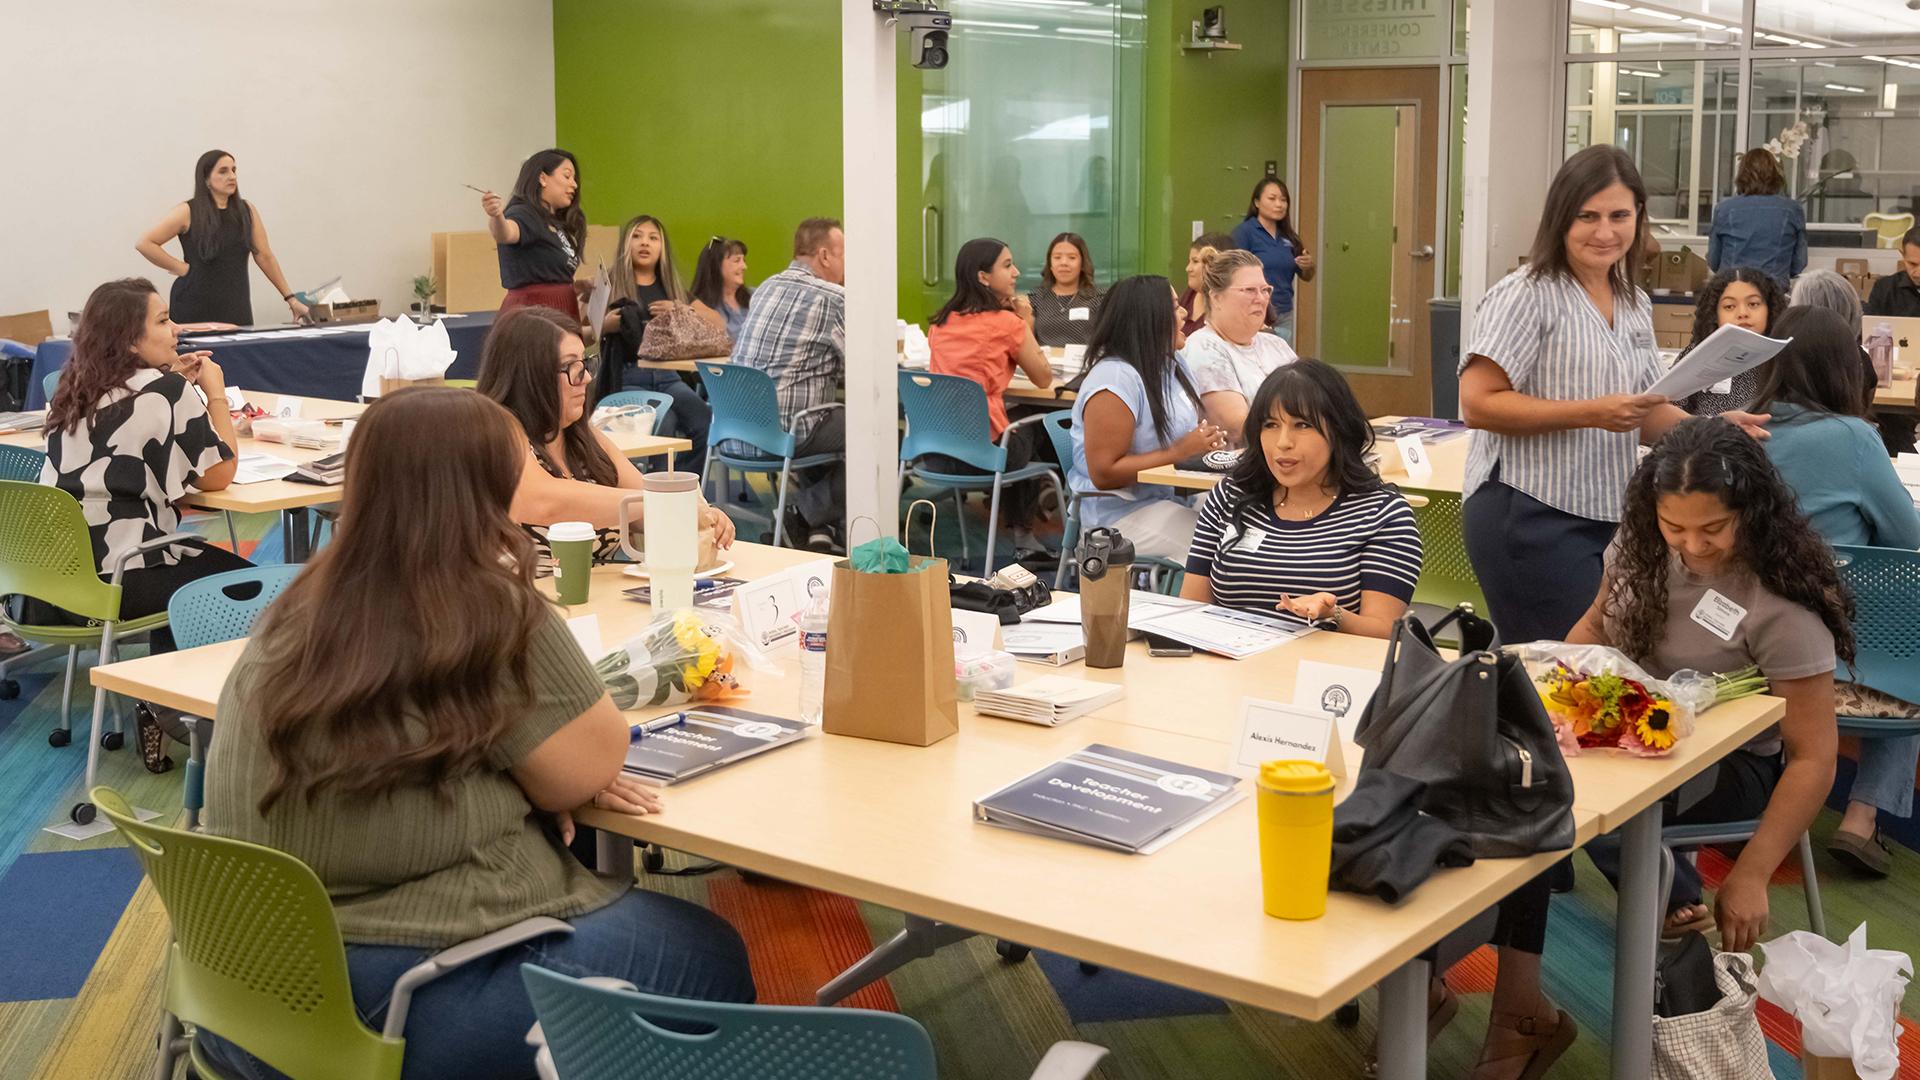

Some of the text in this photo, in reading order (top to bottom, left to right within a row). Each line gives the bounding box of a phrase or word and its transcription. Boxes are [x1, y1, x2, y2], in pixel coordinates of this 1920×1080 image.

[768, 594, 779, 625] 3
[643, 731, 723, 751] velopment
[664, 727, 718, 742] Teacher
[1250, 732, 1317, 752] Alexis Hernandez
[1047, 777, 1163, 814] Development
[1082, 777, 1149, 801] Teacher
